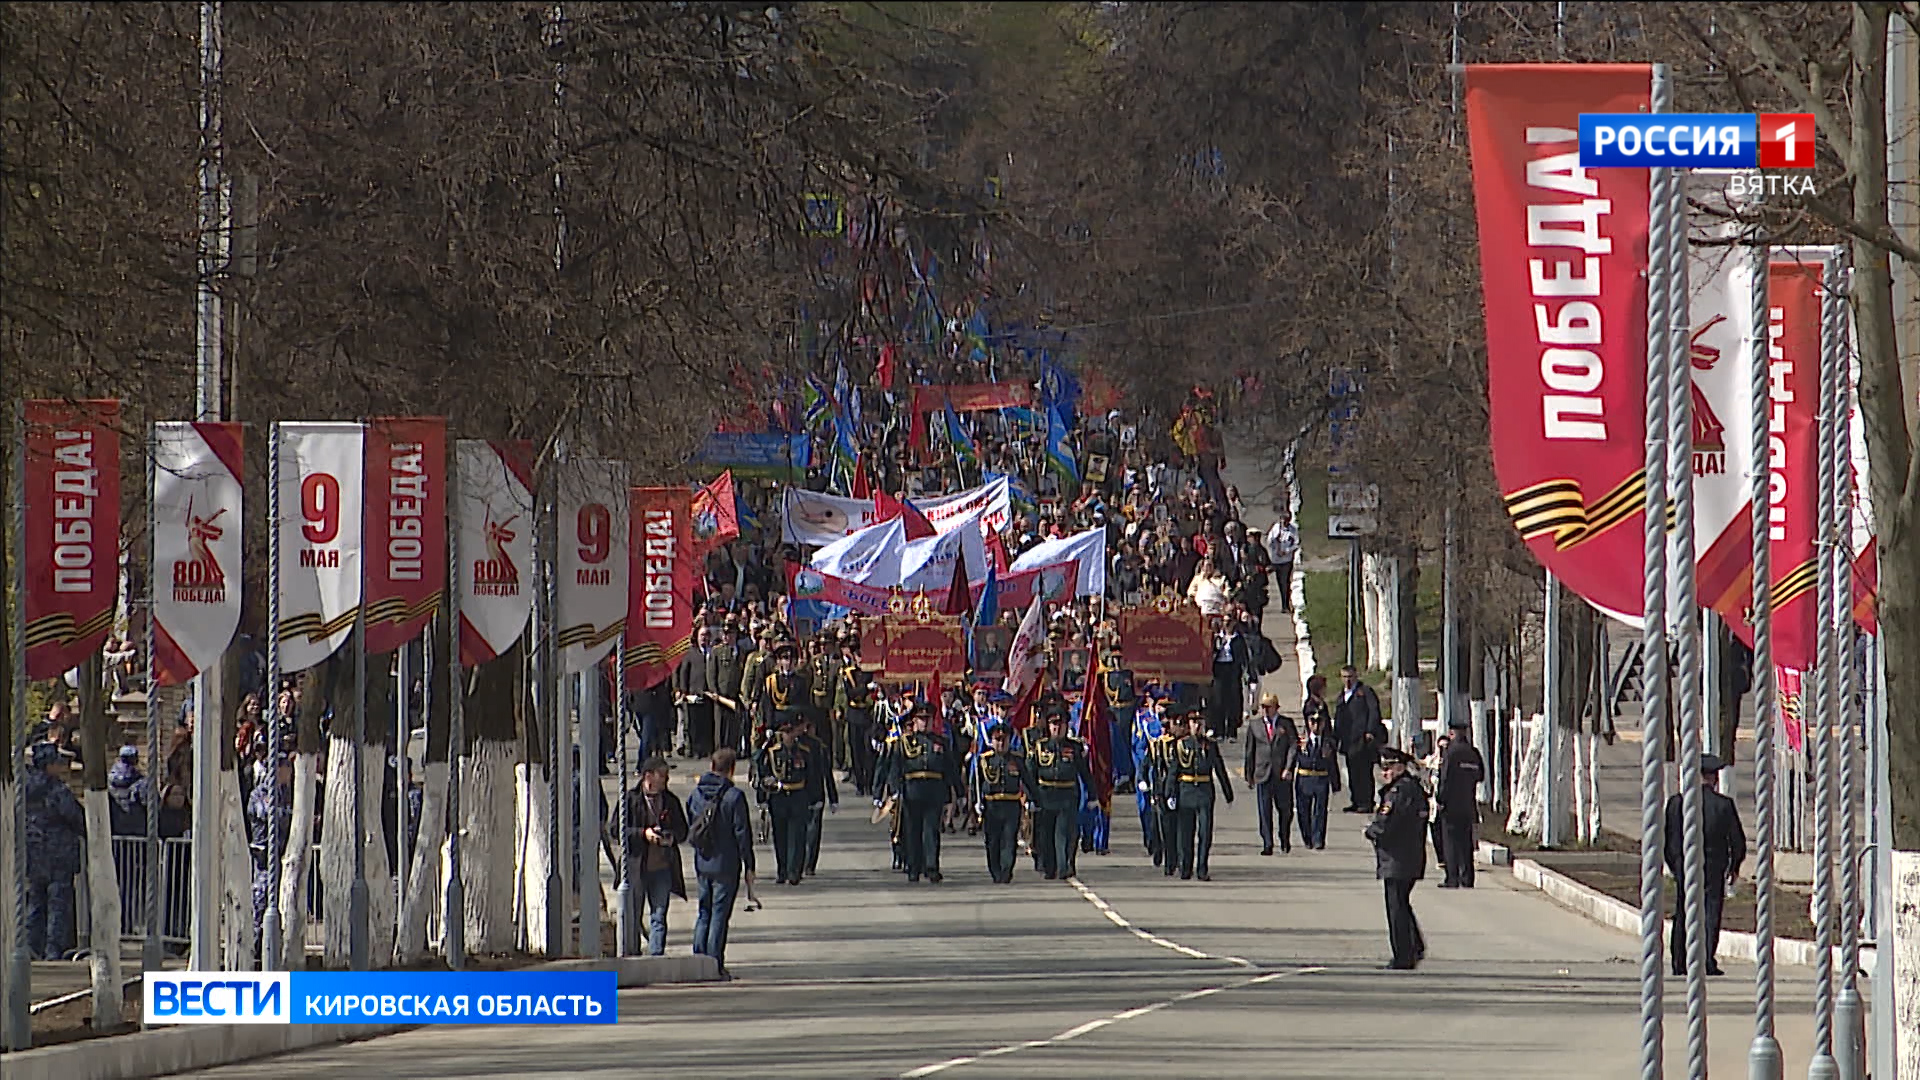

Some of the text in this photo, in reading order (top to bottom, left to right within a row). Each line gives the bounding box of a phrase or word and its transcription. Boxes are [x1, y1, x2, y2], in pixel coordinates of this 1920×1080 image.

[55, 431, 98, 592] ПОБЕДА!
[301, 472, 340, 544] 9
[389, 443, 428, 580] ПОБЕДА!
[577, 503, 611, 564] 9
[300, 549, 339, 568] МАЯ
[474, 560, 499, 581] 80
[645, 510, 677, 628] ПОБЕДА!
[174, 560, 203, 585] 80
[577, 569, 610, 585] МАЯ
[173, 588, 225, 603] ПОБЕДА!
[473, 585, 519, 597] ПОБЕДА!
